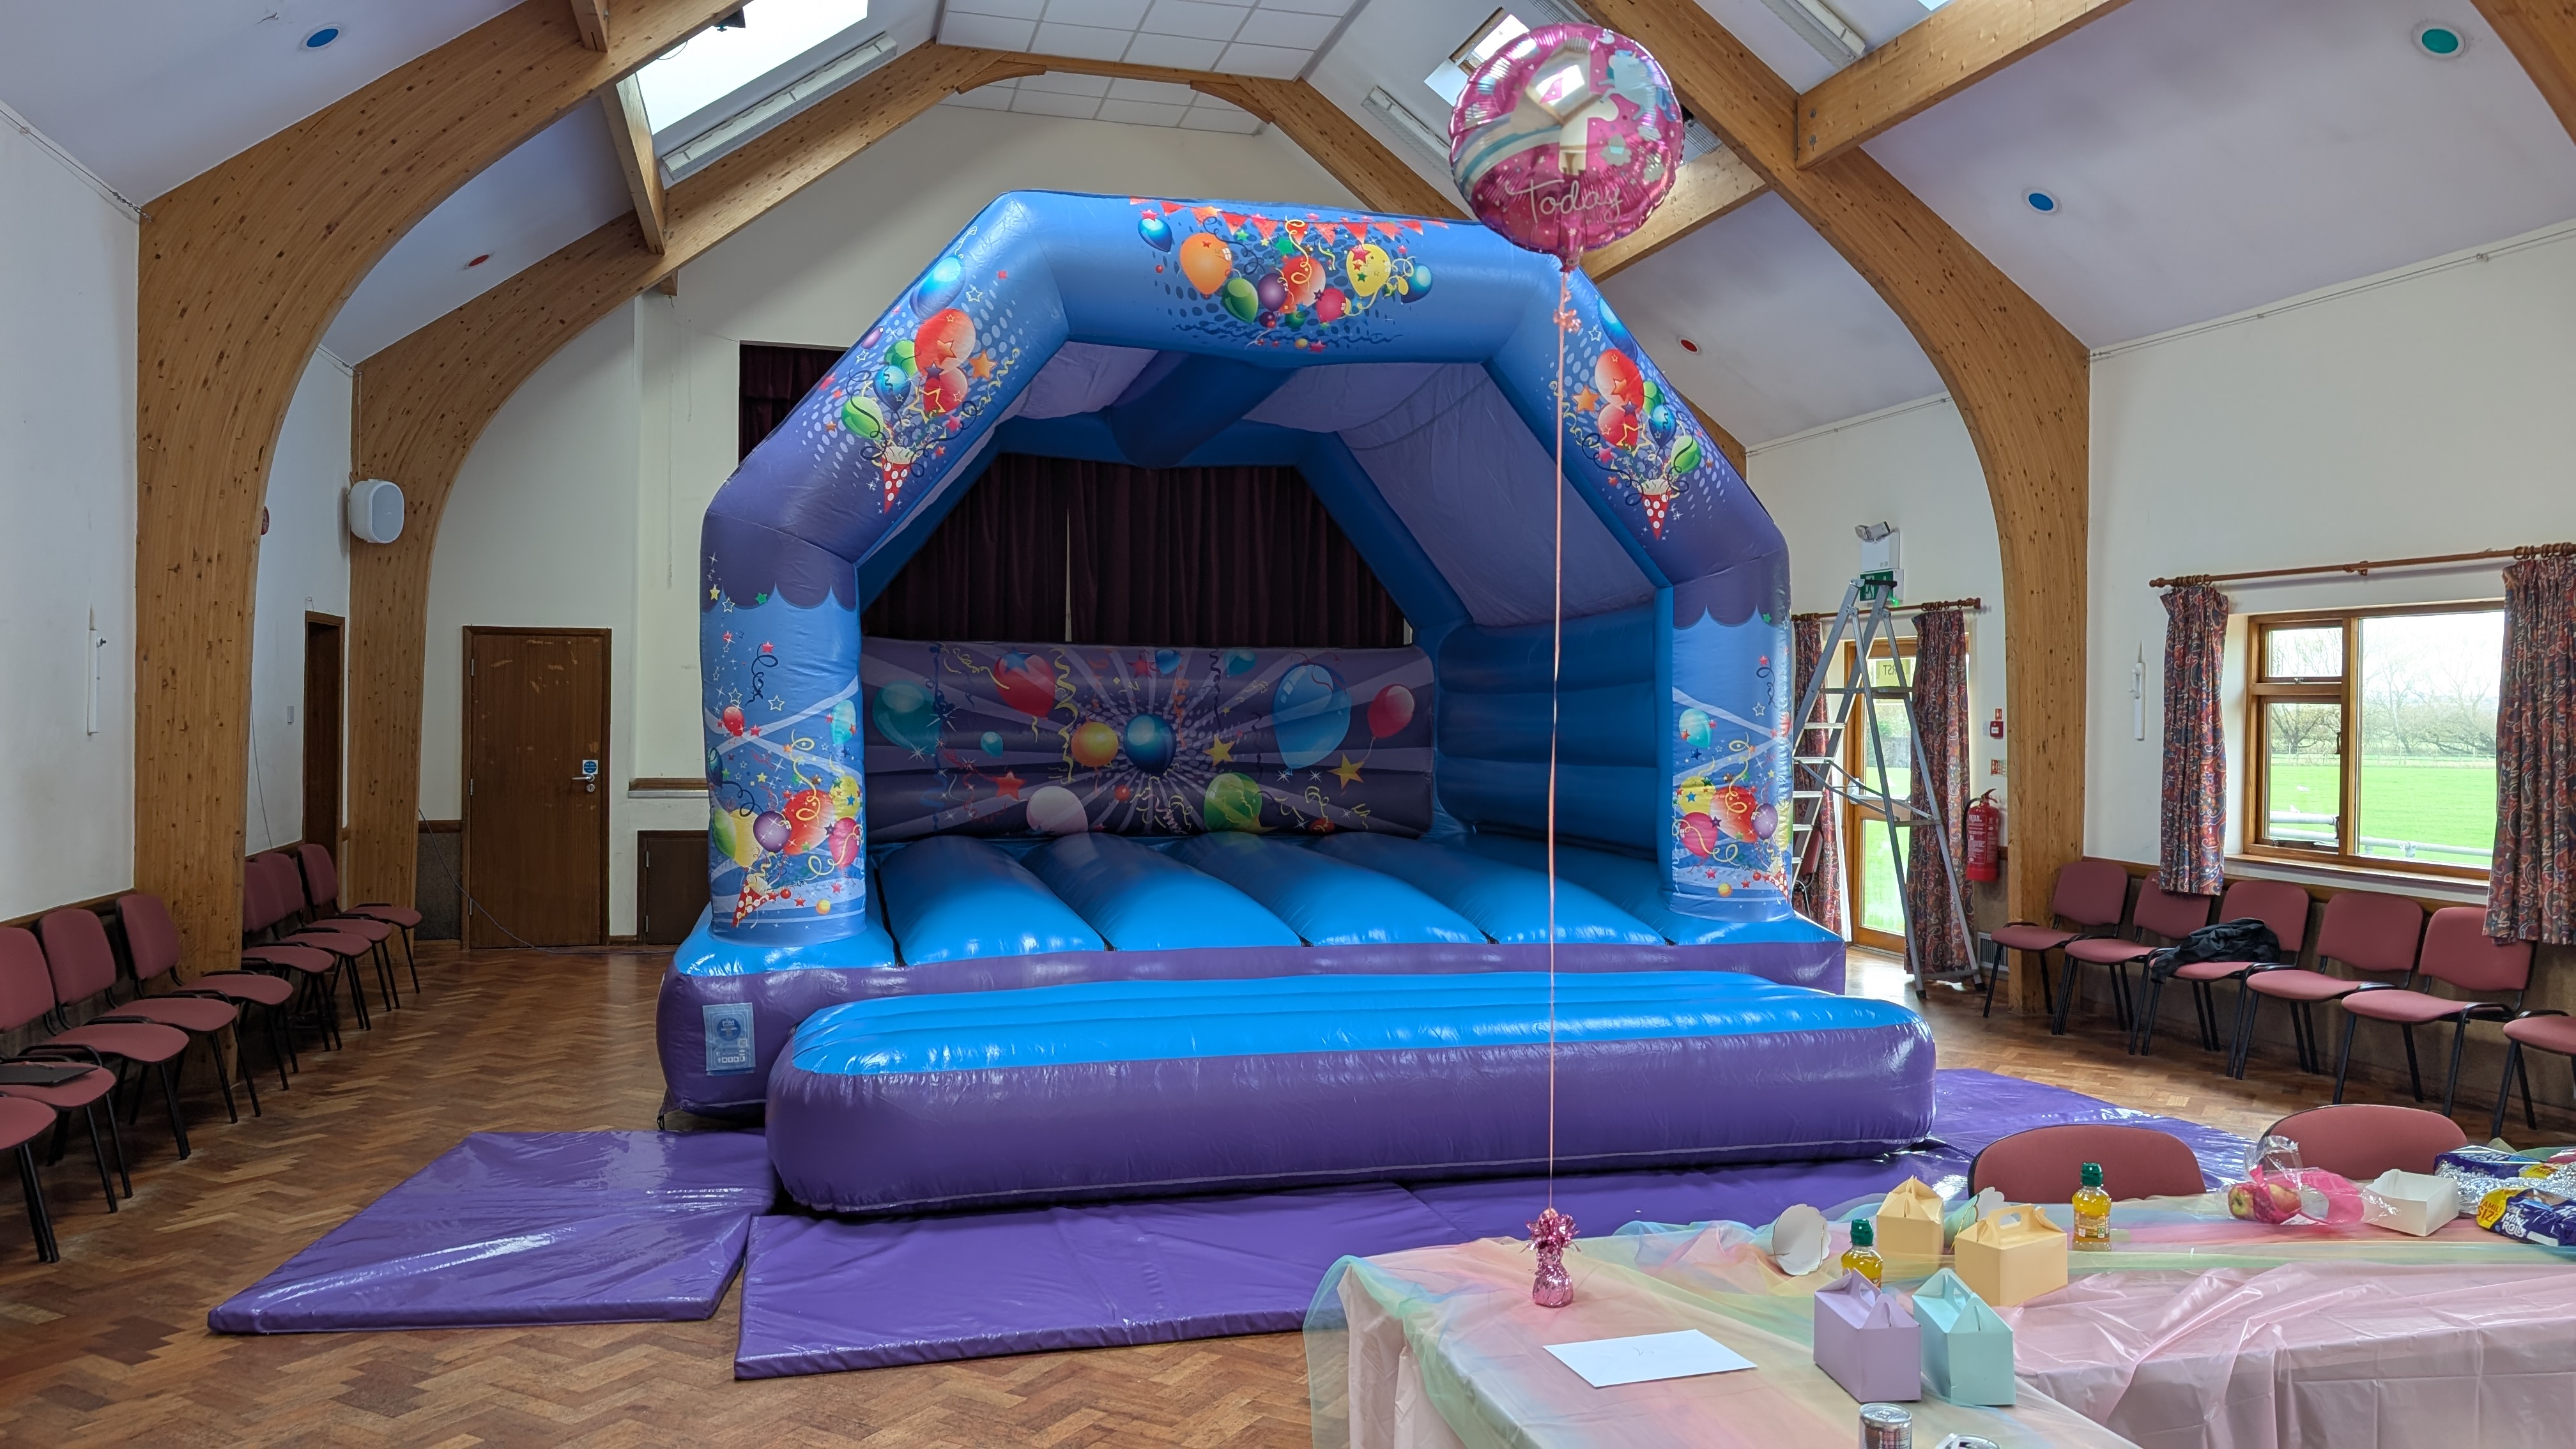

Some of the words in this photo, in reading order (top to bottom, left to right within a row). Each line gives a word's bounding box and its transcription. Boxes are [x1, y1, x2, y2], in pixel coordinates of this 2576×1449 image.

[1505, 179, 1623, 224] Today
[2477, 1206, 2499, 1223] SIZE
[2480, 1199, 2503, 1213] FAMILY
[2501, 1221, 2527, 1238] ROLLS
